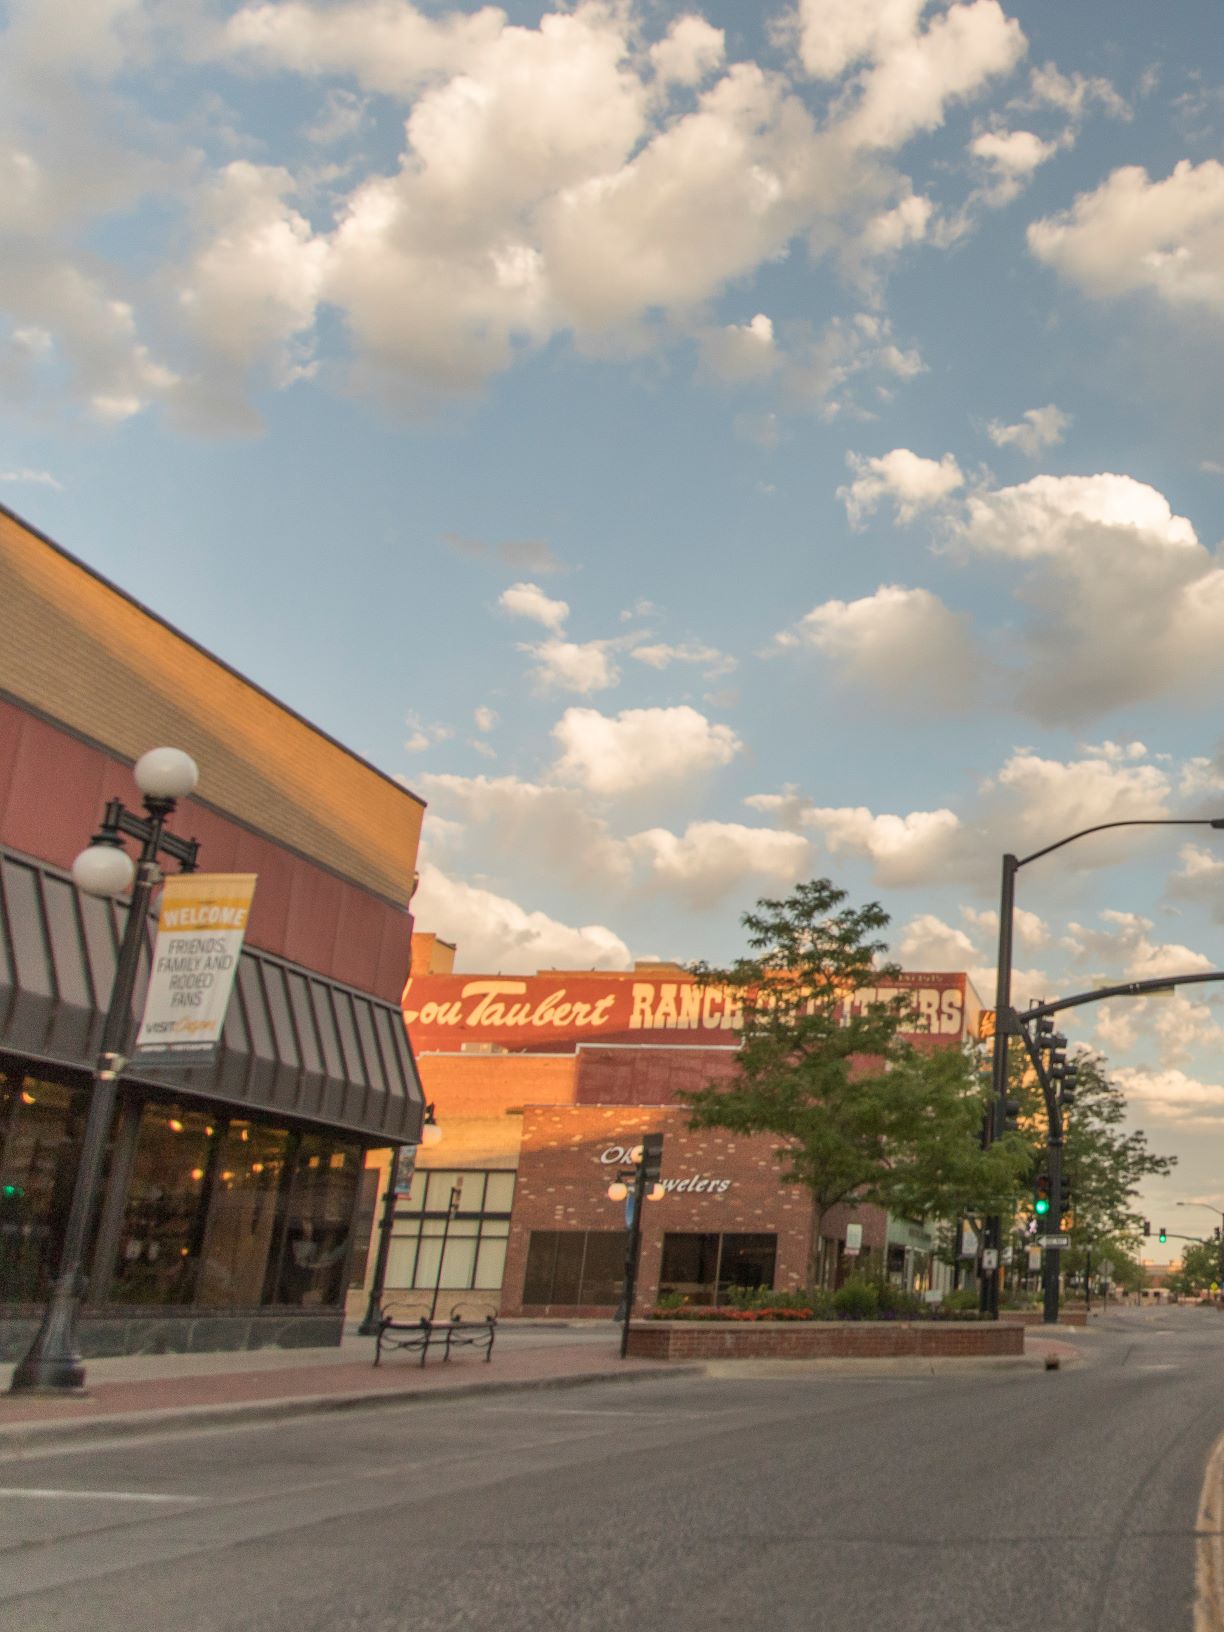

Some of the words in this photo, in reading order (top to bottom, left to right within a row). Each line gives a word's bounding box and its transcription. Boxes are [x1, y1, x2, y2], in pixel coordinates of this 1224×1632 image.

[164, 906, 247, 928] WELCOME
[157, 955, 201, 974] FAMILY
[204, 955, 234, 972] AND
[169, 974, 213, 991] RODEO
[171, 991, 203, 1009] FANS
[401, 978, 463, 1025] Lou
[461, 980, 616, 1027] Taubert
[629, 983, 744, 1031] RANCH
